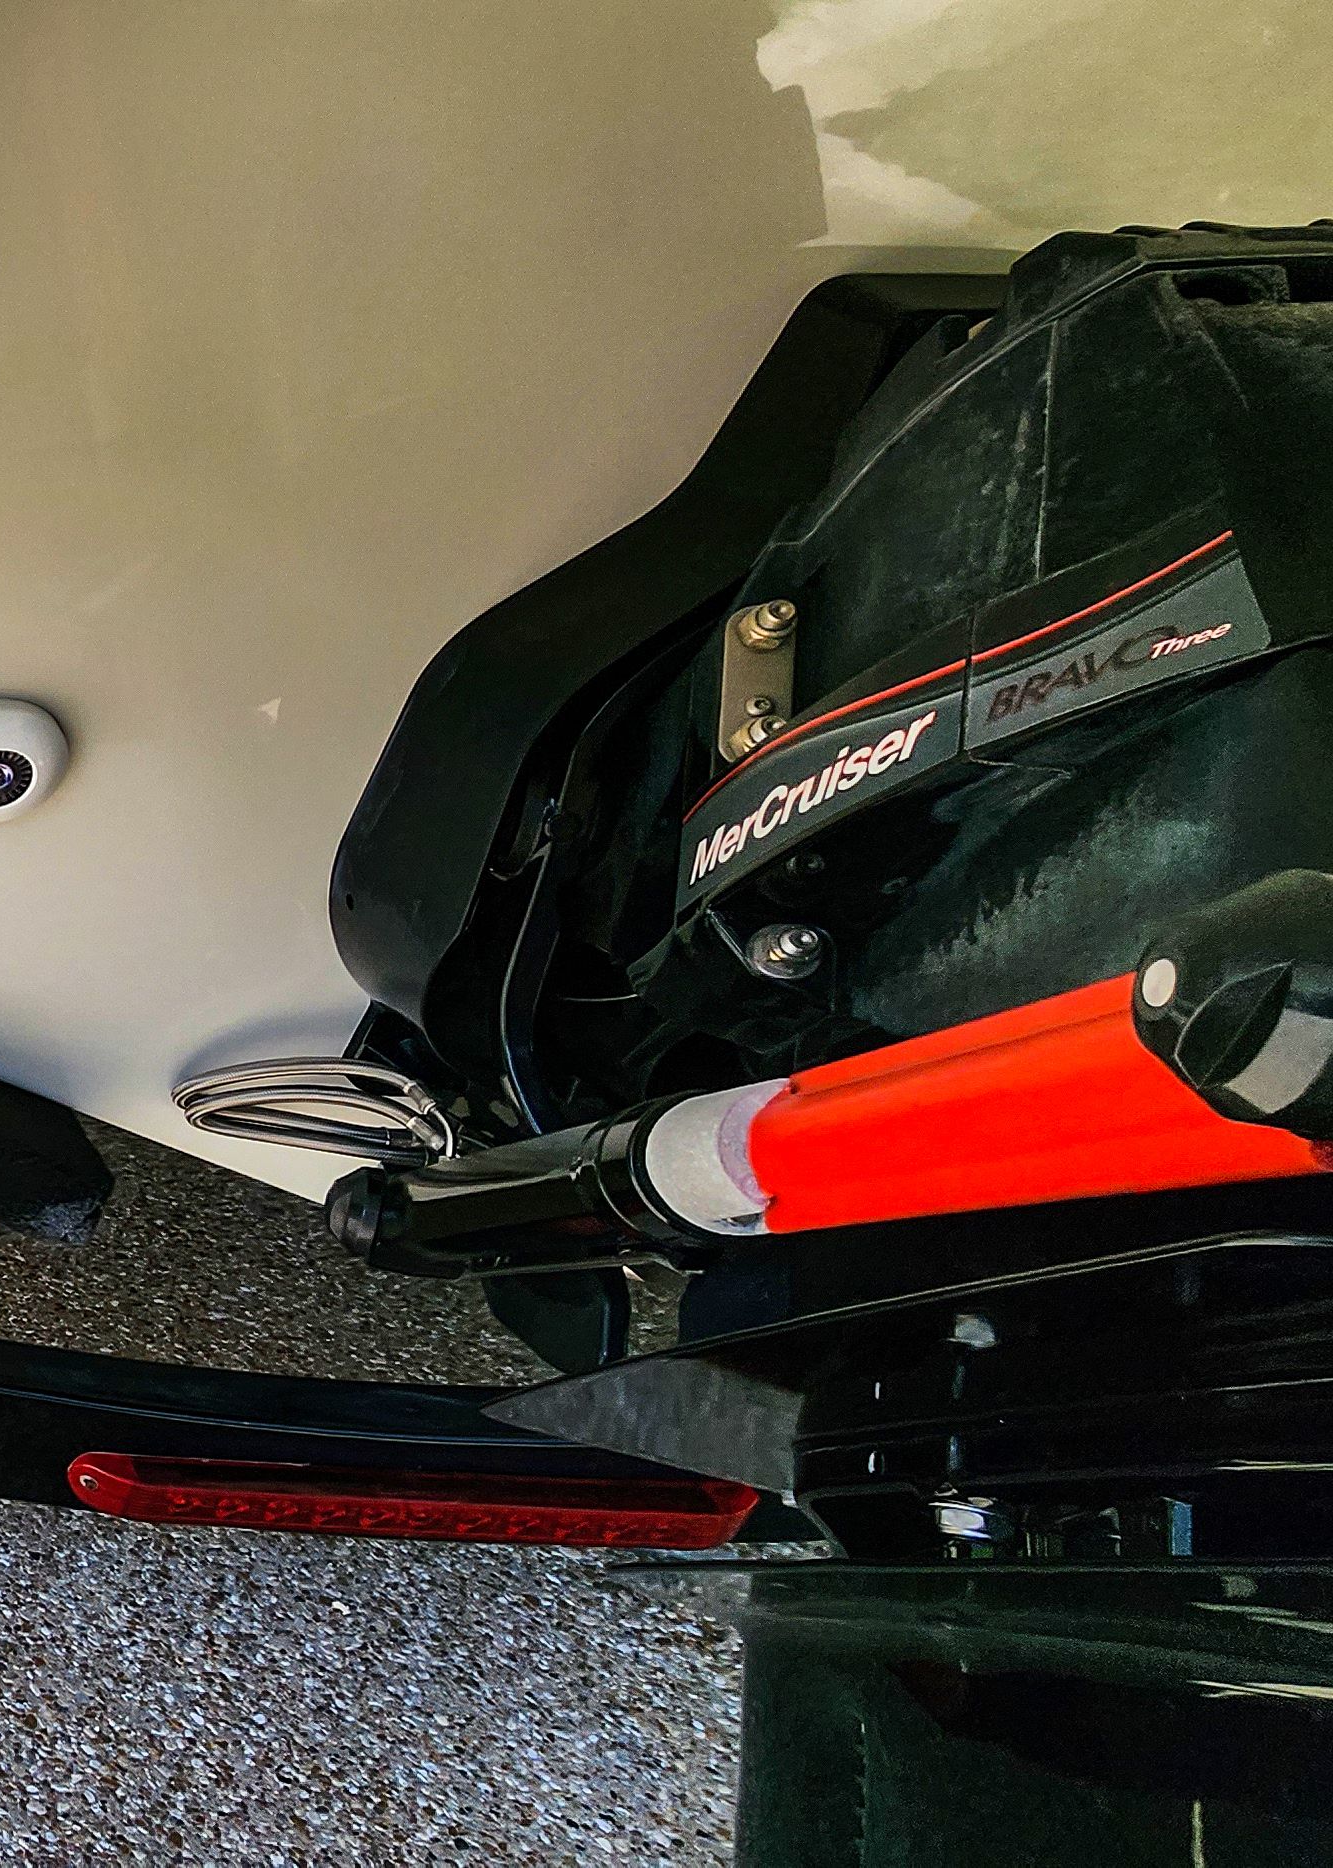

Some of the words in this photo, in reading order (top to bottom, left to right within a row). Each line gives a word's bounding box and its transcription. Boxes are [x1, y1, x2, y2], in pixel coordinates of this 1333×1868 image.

[986, 624, 1179, 722] BRAVO
[1151, 623, 1232, 660] Three
[689, 708, 938, 886] MerCruiser
